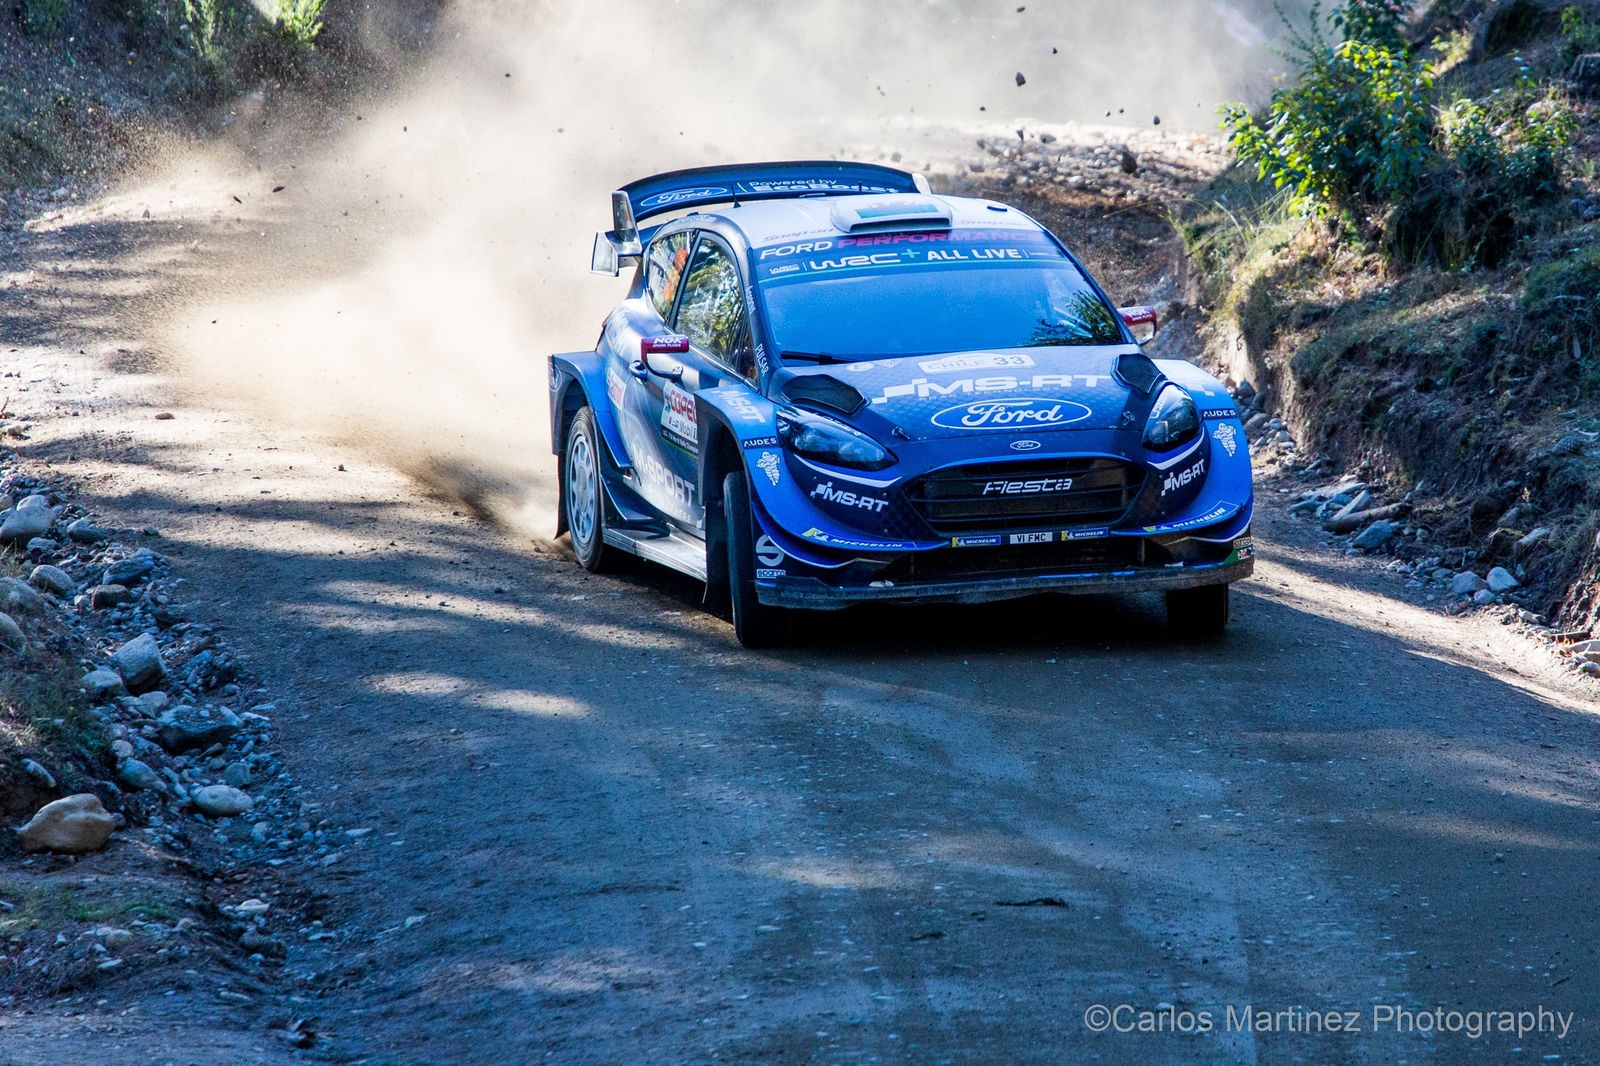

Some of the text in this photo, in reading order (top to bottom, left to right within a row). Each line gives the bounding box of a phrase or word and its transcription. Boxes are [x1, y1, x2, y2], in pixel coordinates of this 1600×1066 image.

[749, 179, 815, 187] Powered
[656, 189, 712, 203] Ford
[760, 241, 833, 260] FORD
[927, 250, 969, 261] ALL
[971, 248, 1022, 259] LIVE
[653, 336, 684, 344] NGK
[756, 343, 769, 377] PULSAR
[993, 356, 1026, 366] 33
[917, 374, 1111, 398] MS-RT
[961, 400, 1064, 426] Ford
[1203, 409, 1236, 418] AUDES
[744, 437, 777, 447] AUDES
[1172, 507, 1226, 529] MICHELIN
[1074, 530, 1105, 538] MICHELIN
[831, 537, 904, 549] MICHELIN
[965, 537, 997, 545] MICHELIN
